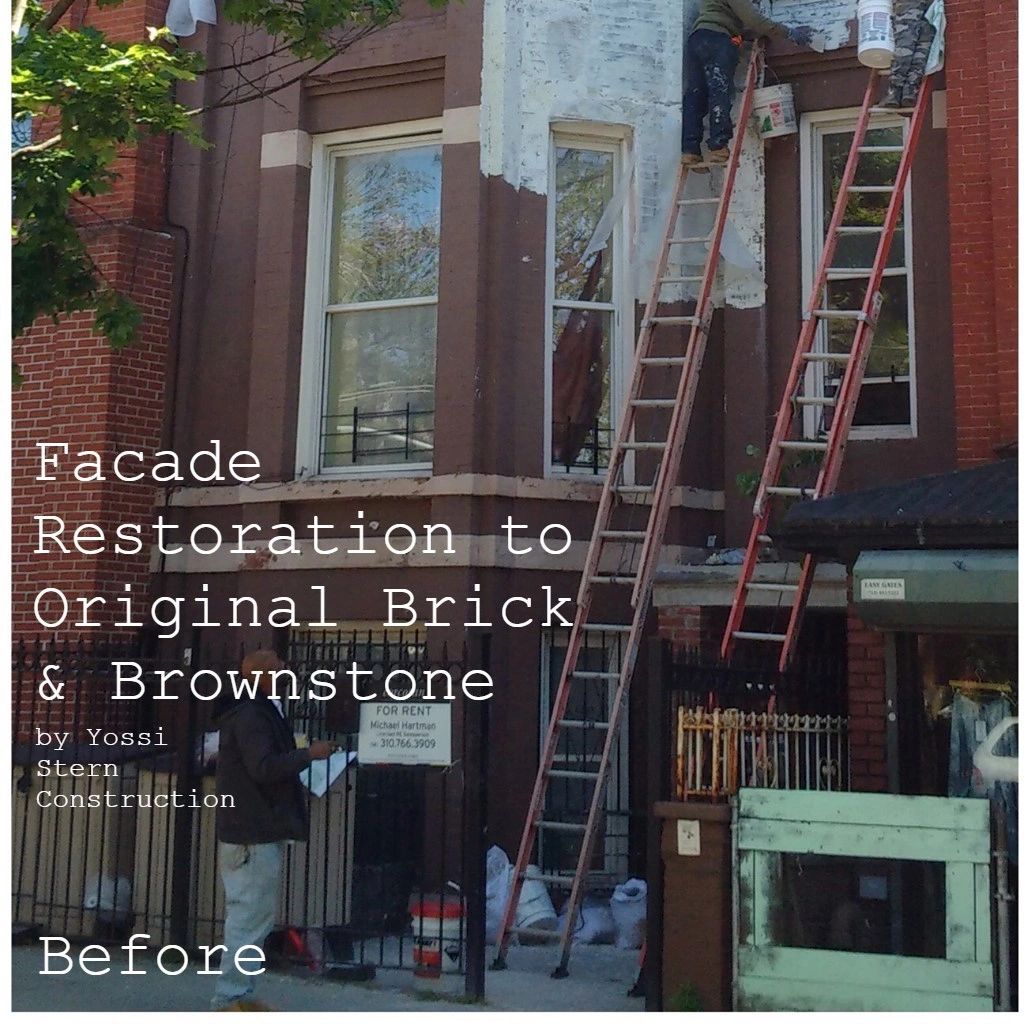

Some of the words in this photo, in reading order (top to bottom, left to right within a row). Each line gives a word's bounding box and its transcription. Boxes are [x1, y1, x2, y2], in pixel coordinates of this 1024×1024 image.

[376, 705, 398, 716] FOR
[402, 705, 432, 716] RENT
[370, 720, 400, 730] Michael
[401, 720, 437, 731] Hartman
